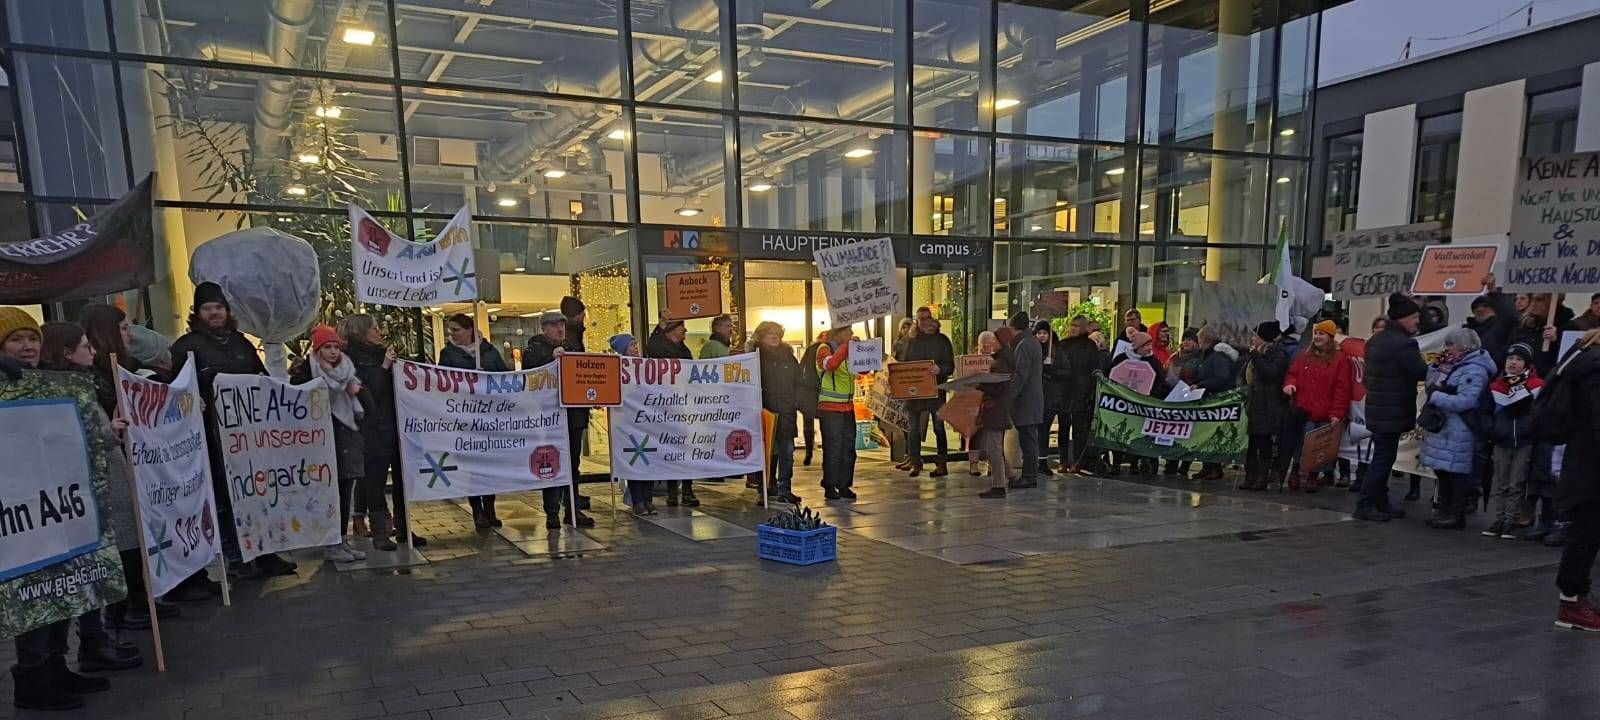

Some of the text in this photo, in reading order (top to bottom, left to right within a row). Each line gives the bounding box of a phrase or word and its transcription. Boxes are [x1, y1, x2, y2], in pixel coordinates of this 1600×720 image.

[1527, 154, 1578, 181] KEINE
[1541, 206, 1600, 224] HAUSTÜ
[1553, 223, 1574, 240] &
[919, 241, 970, 258] campus
[1512, 241, 1551, 260] NICHT
[1558, 240, 1578, 259] VOR
[679, 275, 708, 287] Asbeck
[1508, 266, 1557, 286] UNSERER
[367, 286, 438, 301] unser Leben
[576, 359, 606, 369] Holzen
[622, 358, 751, 385] STOPP A46 B7n
[403, 361, 479, 394] STOPP
[121, 379, 168, 428] STOPP
[266, 384, 308, 421] A46
[446, 399, 516, 413] Schützt die
[643, 393, 730, 406] Erhaltet unsere
[1099, 395, 1239, 421] MOBILITÄTSWENDE
[404, 411, 560, 433] Historische Klosterlandschaft
[1144, 421, 1190, 436] JETZT!
[229, 428, 326, 454] an unserem
[455, 436, 526, 453] Oelinghausen
[659, 432, 717, 445] Unser Land
[664, 448, 715, 461] euer Brot
[226, 458, 331, 508] indegarten
[0, 483, 86, 537] hn A46
